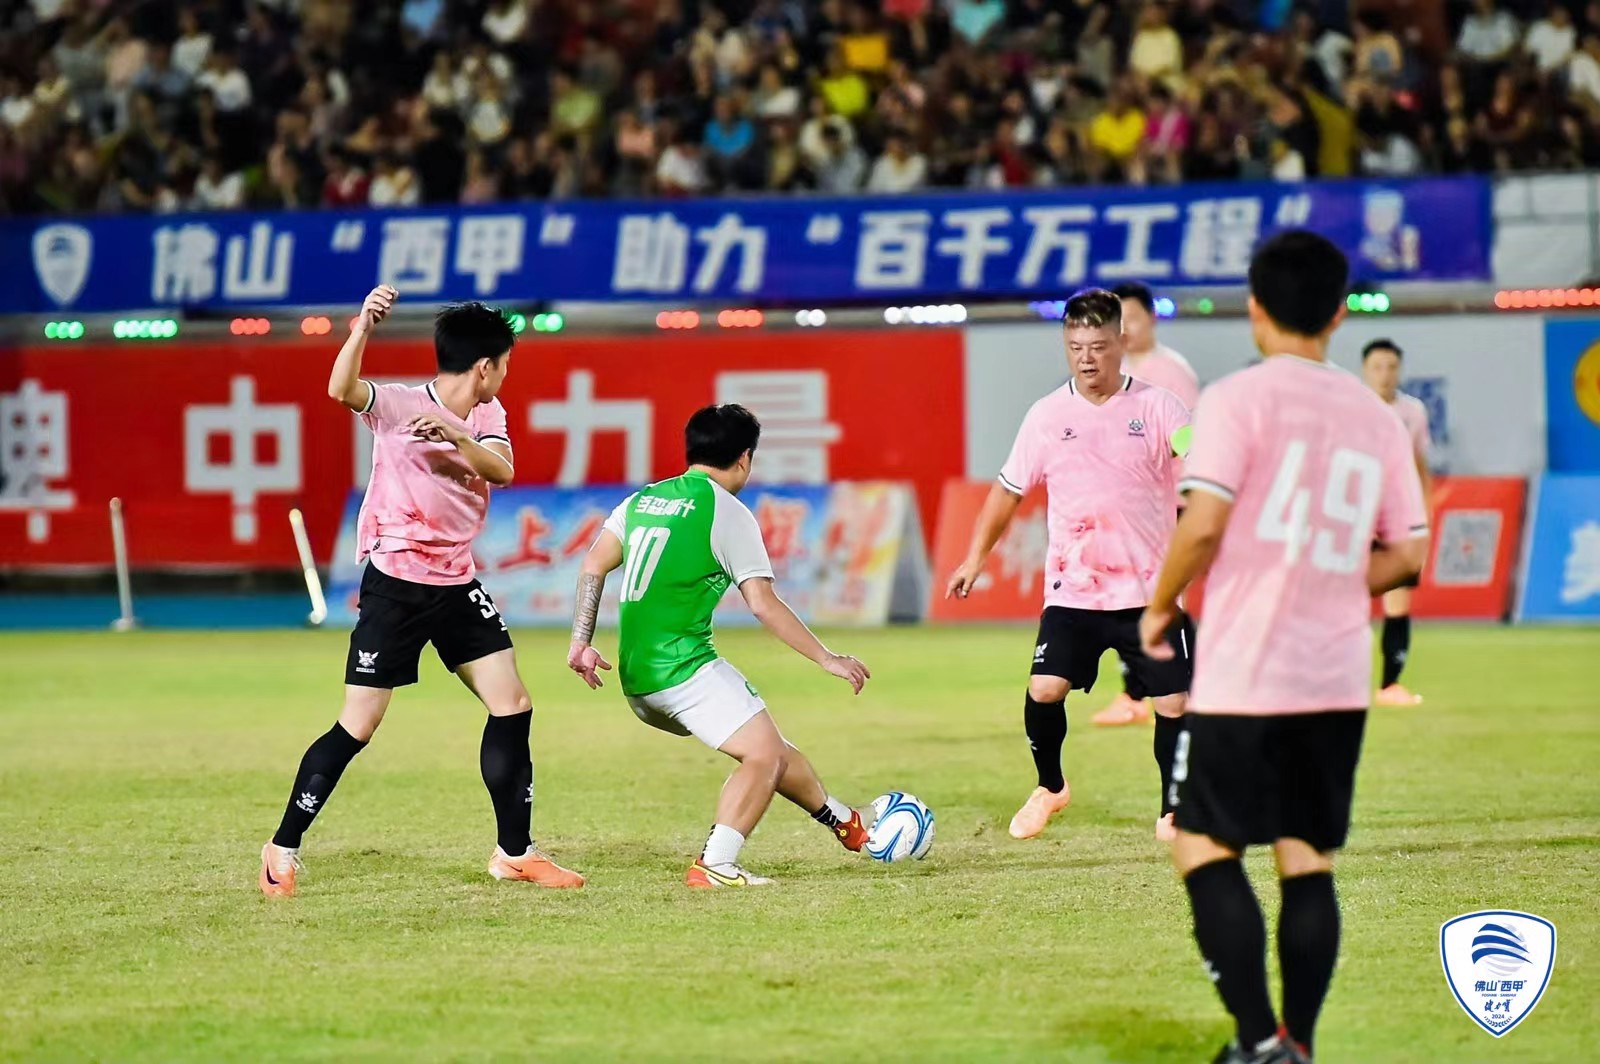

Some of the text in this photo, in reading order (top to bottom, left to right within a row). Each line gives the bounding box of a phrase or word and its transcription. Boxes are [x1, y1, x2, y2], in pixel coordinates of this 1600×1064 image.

[1256, 440, 1383, 575] 49
[468, 585, 499, 619] 3
[620, 526, 671, 602] 10
